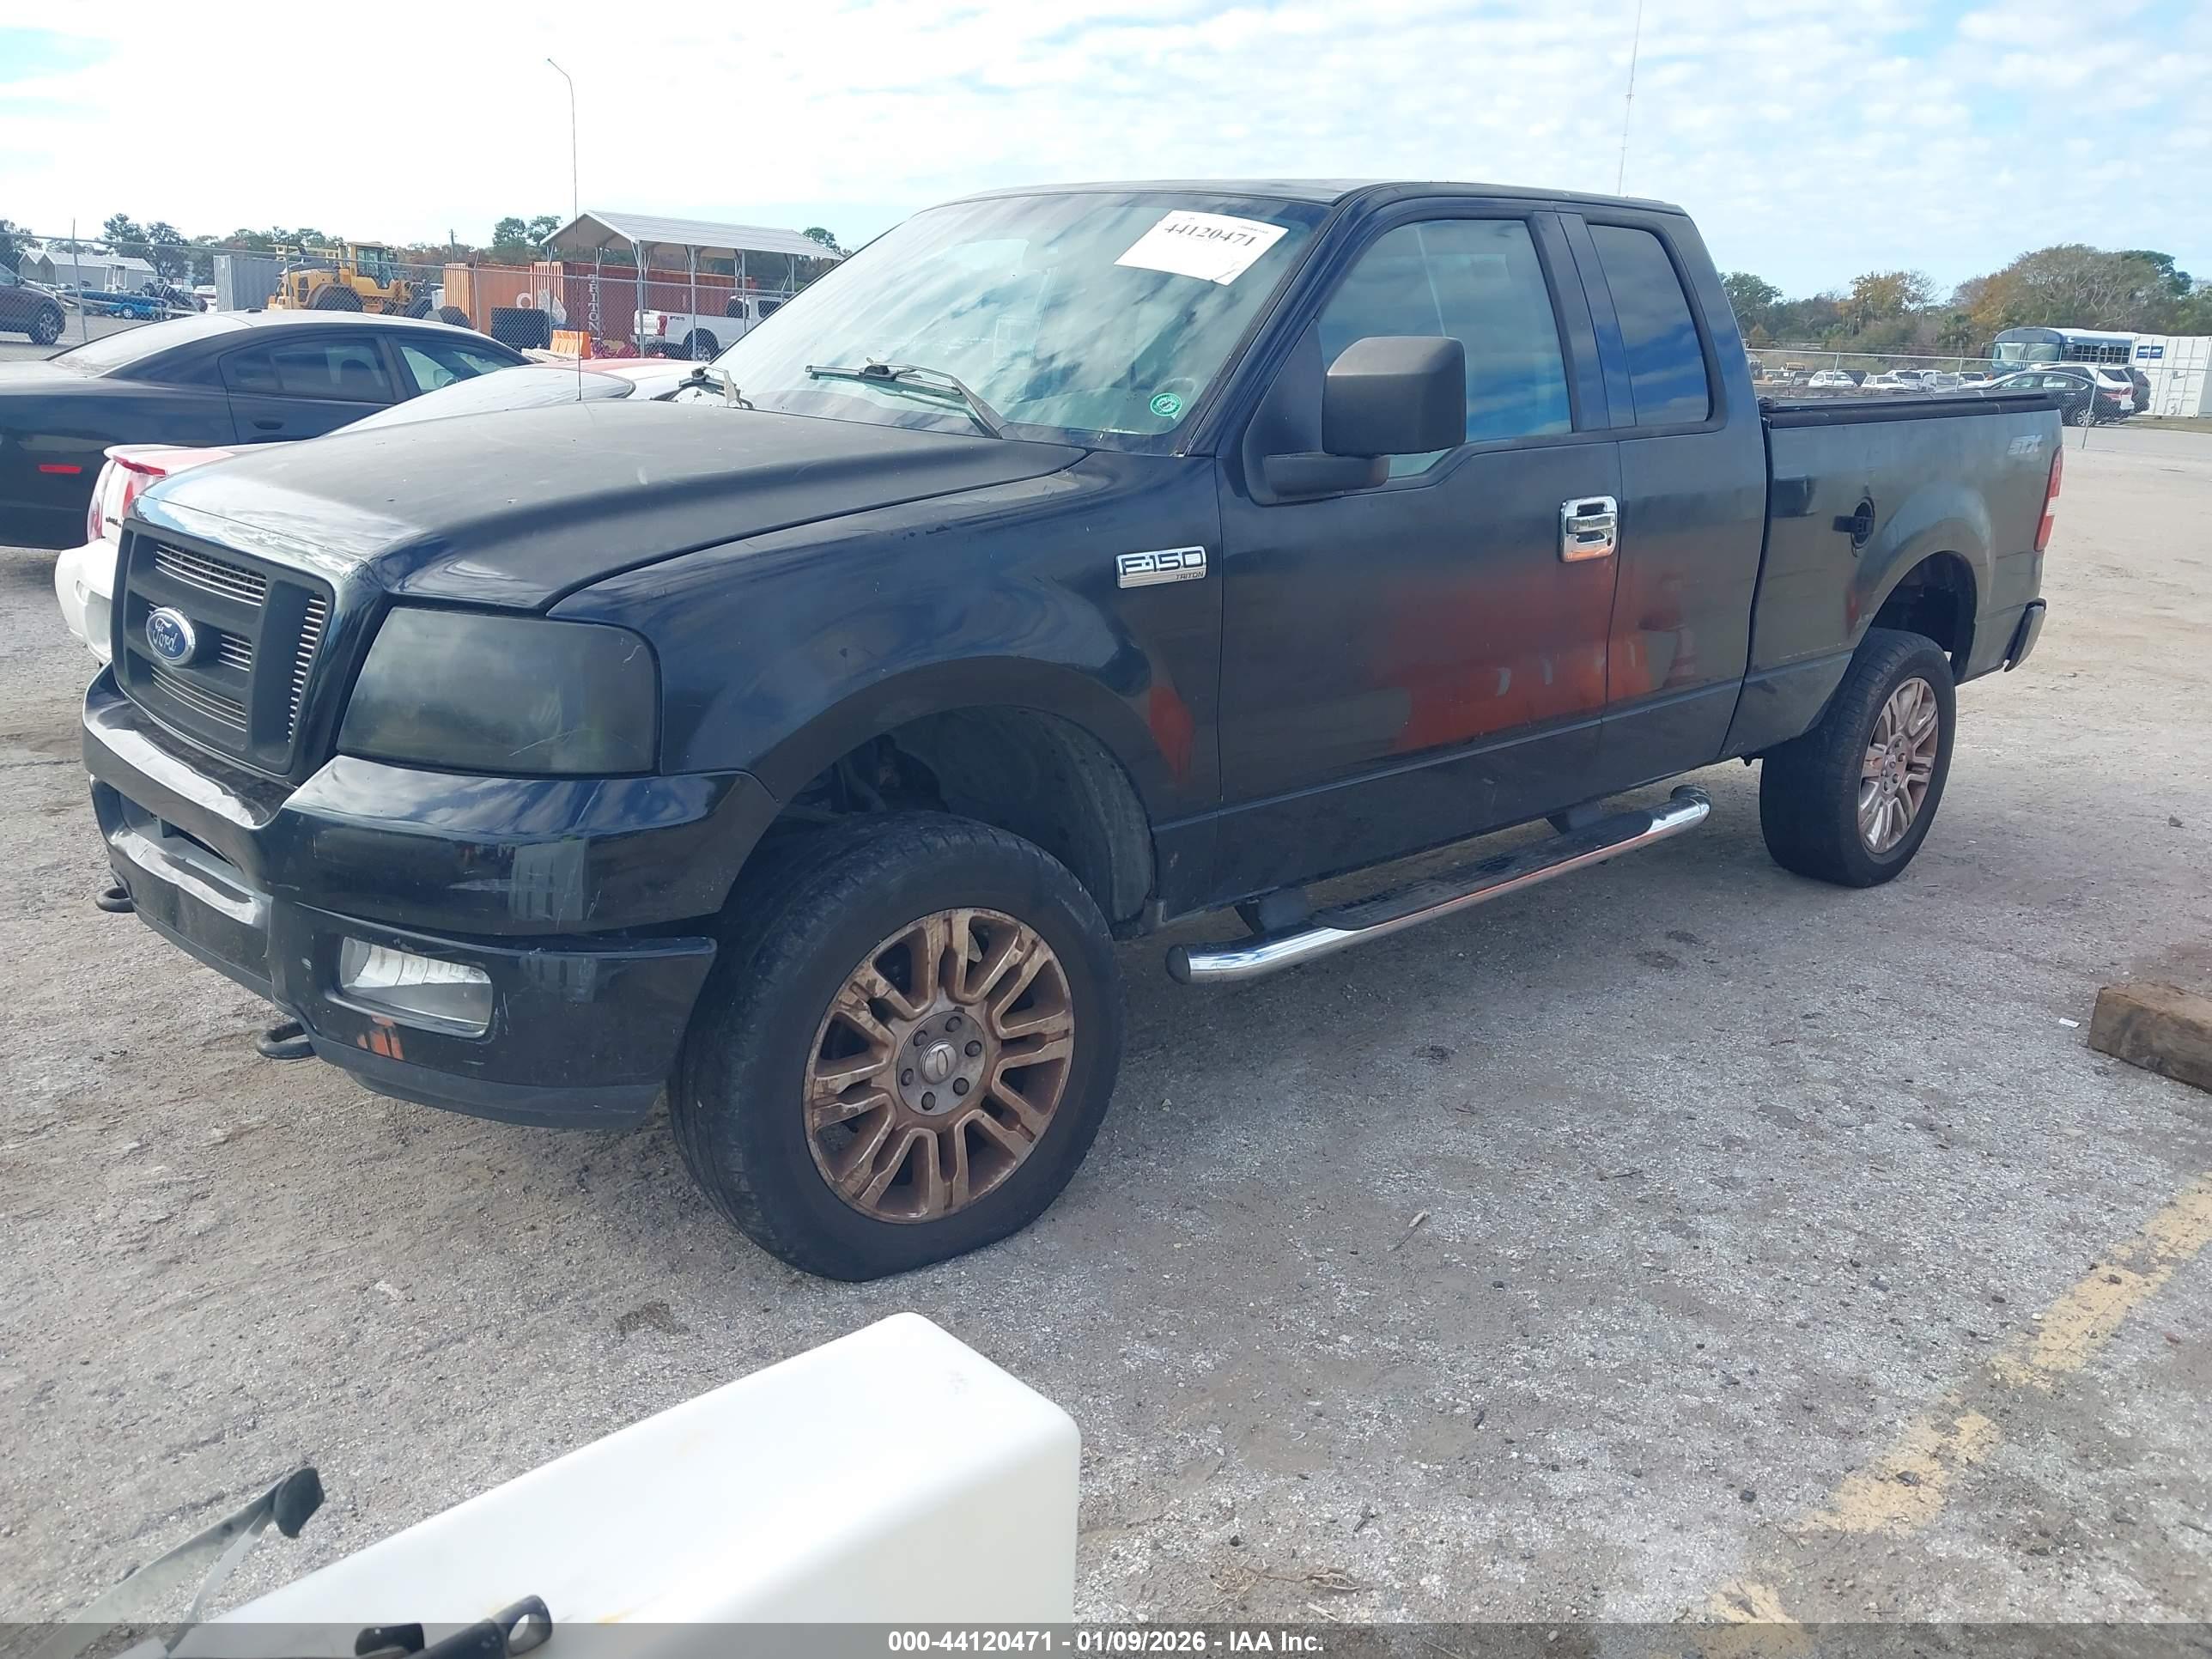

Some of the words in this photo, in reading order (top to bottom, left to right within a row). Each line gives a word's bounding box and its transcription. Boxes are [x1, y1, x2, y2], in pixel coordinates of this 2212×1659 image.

[1164, 223, 1257, 246] 44120471
[1176, 571, 1204, 580] TRITON
[153, 617, 178, 653] Ford
